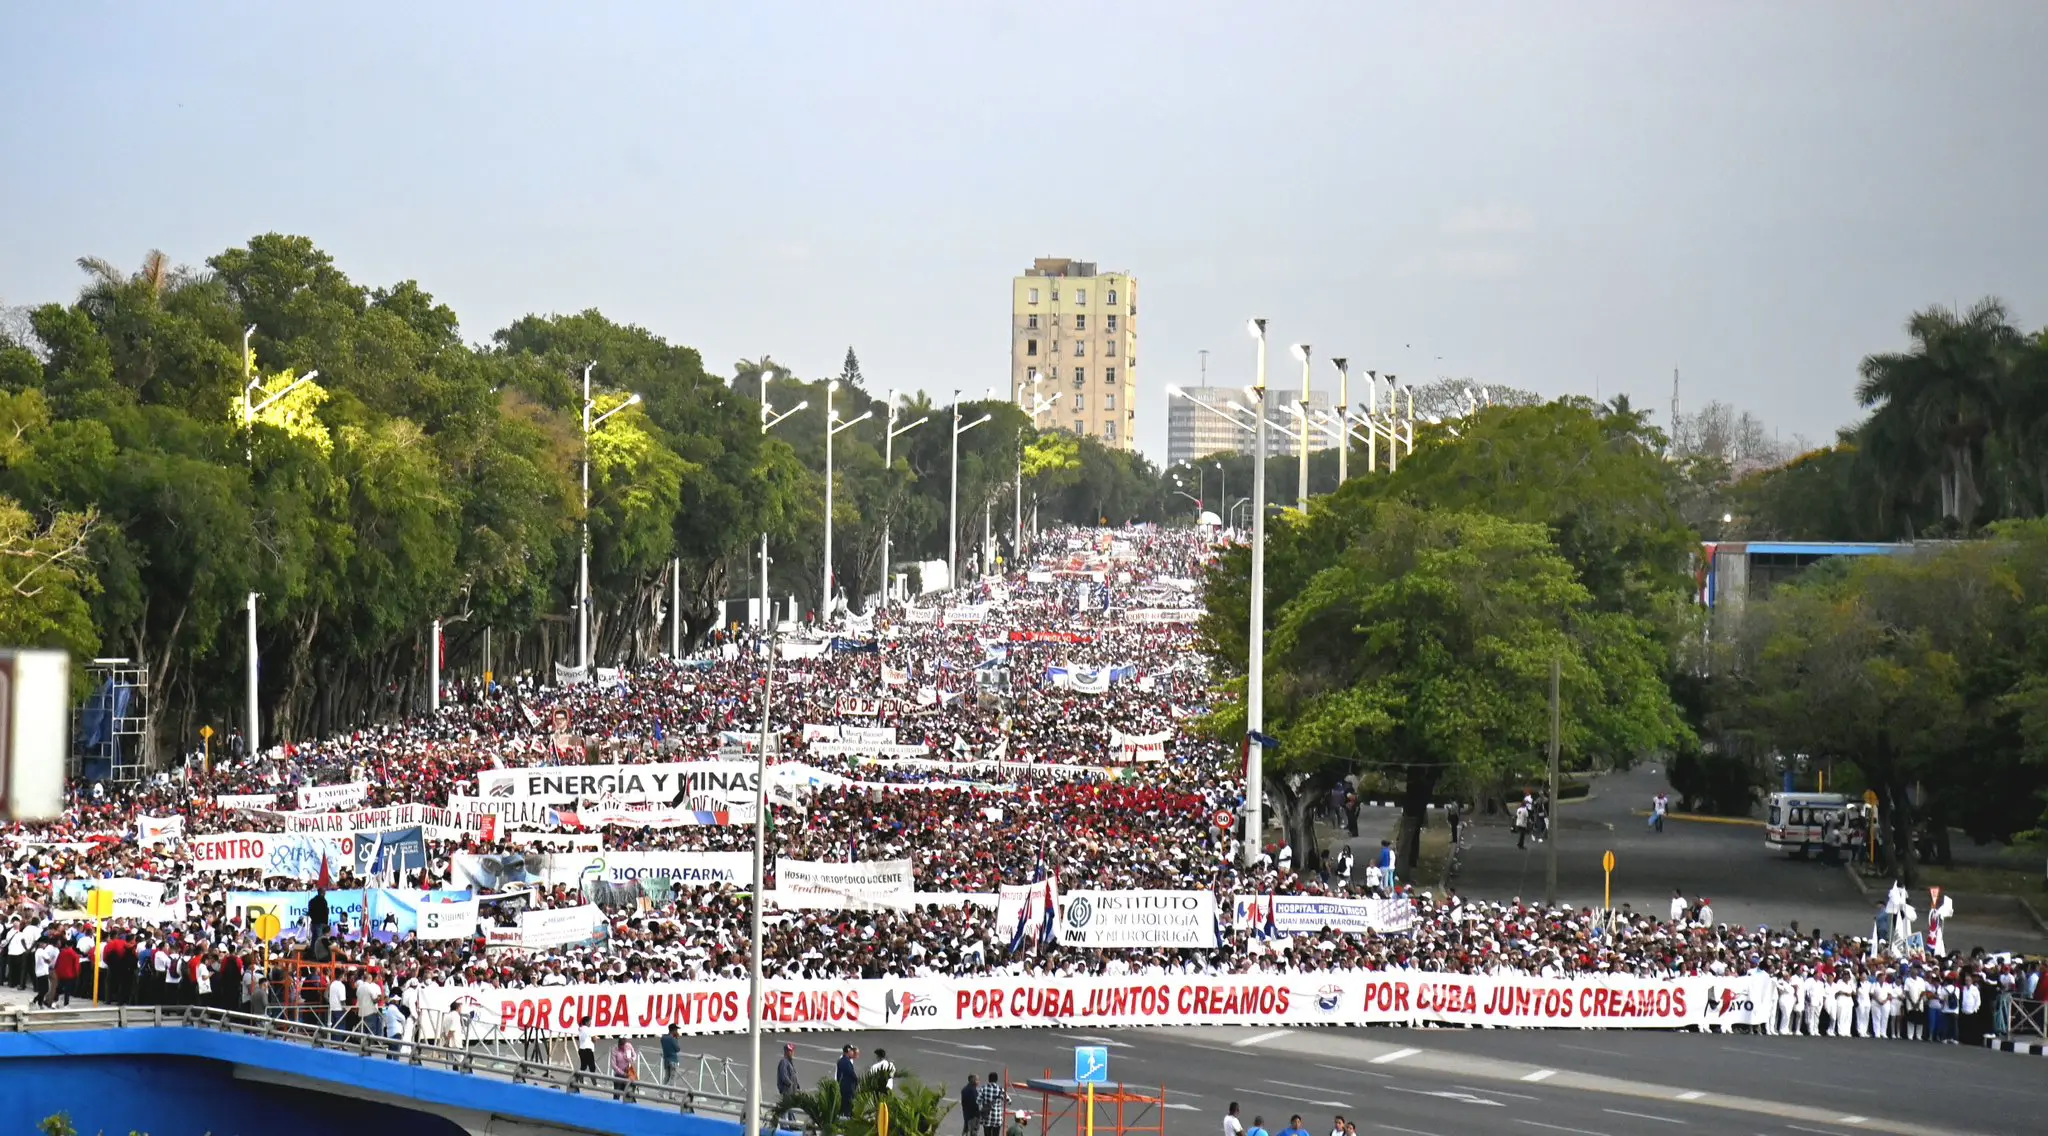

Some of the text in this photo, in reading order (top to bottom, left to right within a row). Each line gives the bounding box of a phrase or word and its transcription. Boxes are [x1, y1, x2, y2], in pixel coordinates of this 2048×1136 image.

[861, 699, 875, 713] DE
[529, 769, 759, 795] ENERGÍA Y MINAS
[348, 809, 391, 831] SIEMPRE
[396, 805, 414, 825] FIEL
[418, 806, 451, 828] JUNTO
[454, 812, 462, 830] A
[467, 813, 482, 831] FID
[1217, 814, 1229, 822] 50
[195, 839, 264, 861] CENTRO
[347, 902, 362, 913] de
[1097, 896, 1198, 910] INSTITUTO
[1278, 903, 1317, 913] HOSPITAL
[1114, 912, 1199, 926] NEUROLOGÍA
[1065, 930, 1087, 942] INN
[1095, 928, 1199, 942] Y NEUROCIRUGÍA
[500, 997, 553, 1031] POR
[559, 993, 630, 1029] CUBA
[639, 991, 739, 1027] JUNTOS
[956, 988, 1004, 1020] POR
[1010, 986, 1075, 1018] CUBA
[1081, 984, 1171, 1018] JUNTOS
[1177, 985, 1290, 1016] CREAMOS
[1363, 982, 1410, 1013] POR
[1416, 982, 1477, 1014] CUBA
[1483, 985, 1573, 1017] JUNTOS
[1579, 986, 1687, 1018] CREAMOS
